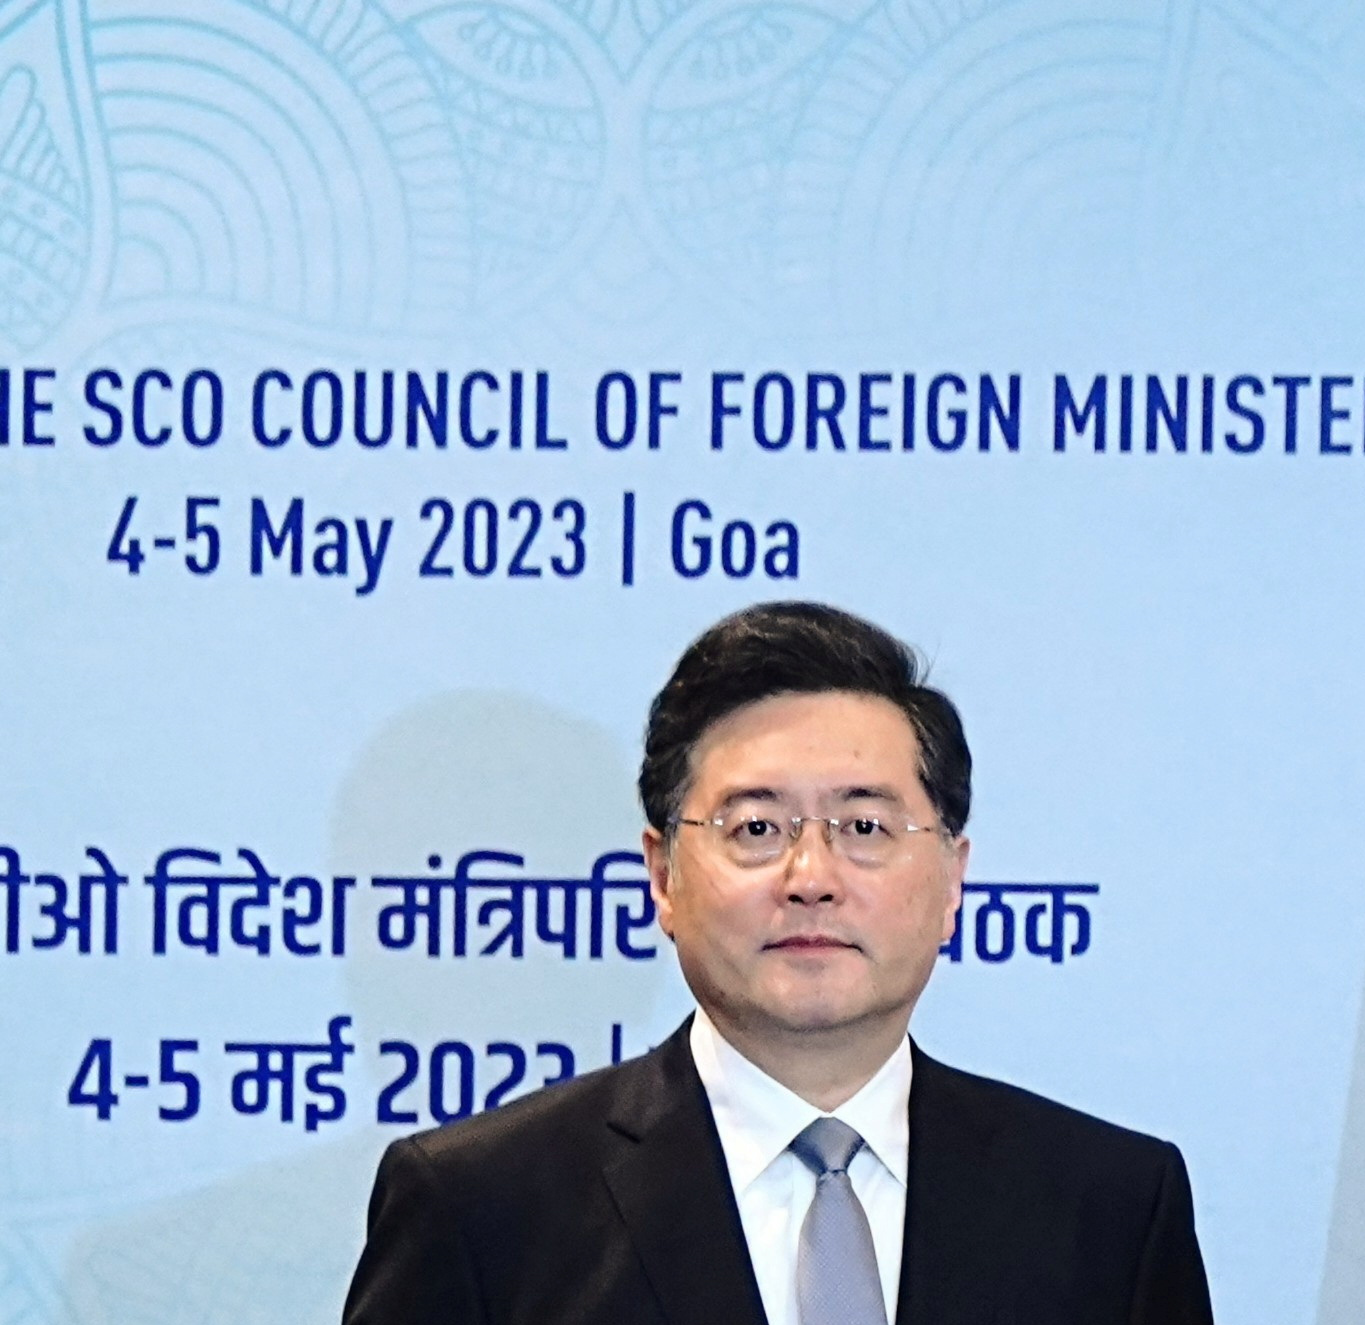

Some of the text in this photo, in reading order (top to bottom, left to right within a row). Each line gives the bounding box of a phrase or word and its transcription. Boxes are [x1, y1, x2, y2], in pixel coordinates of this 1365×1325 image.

[83, 368, 224, 448] SCO
[252, 369, 568, 450] COUNCIL
[595, 371, 682, 451] OF
[710, 371, 1021, 453] FOREIGN
[107, 496, 220, 576] 4-5
[250, 497, 394, 597] May
[419, 497, 586, 578] 2023
[671, 499, 800, 579] Goa
[143, 847, 357, 956] विदेश
[371, 850, 657, 960] मंत्रिपरि
[67, 1038, 201, 1122] 4-5
[224, 1015, 355, 1132] मई
